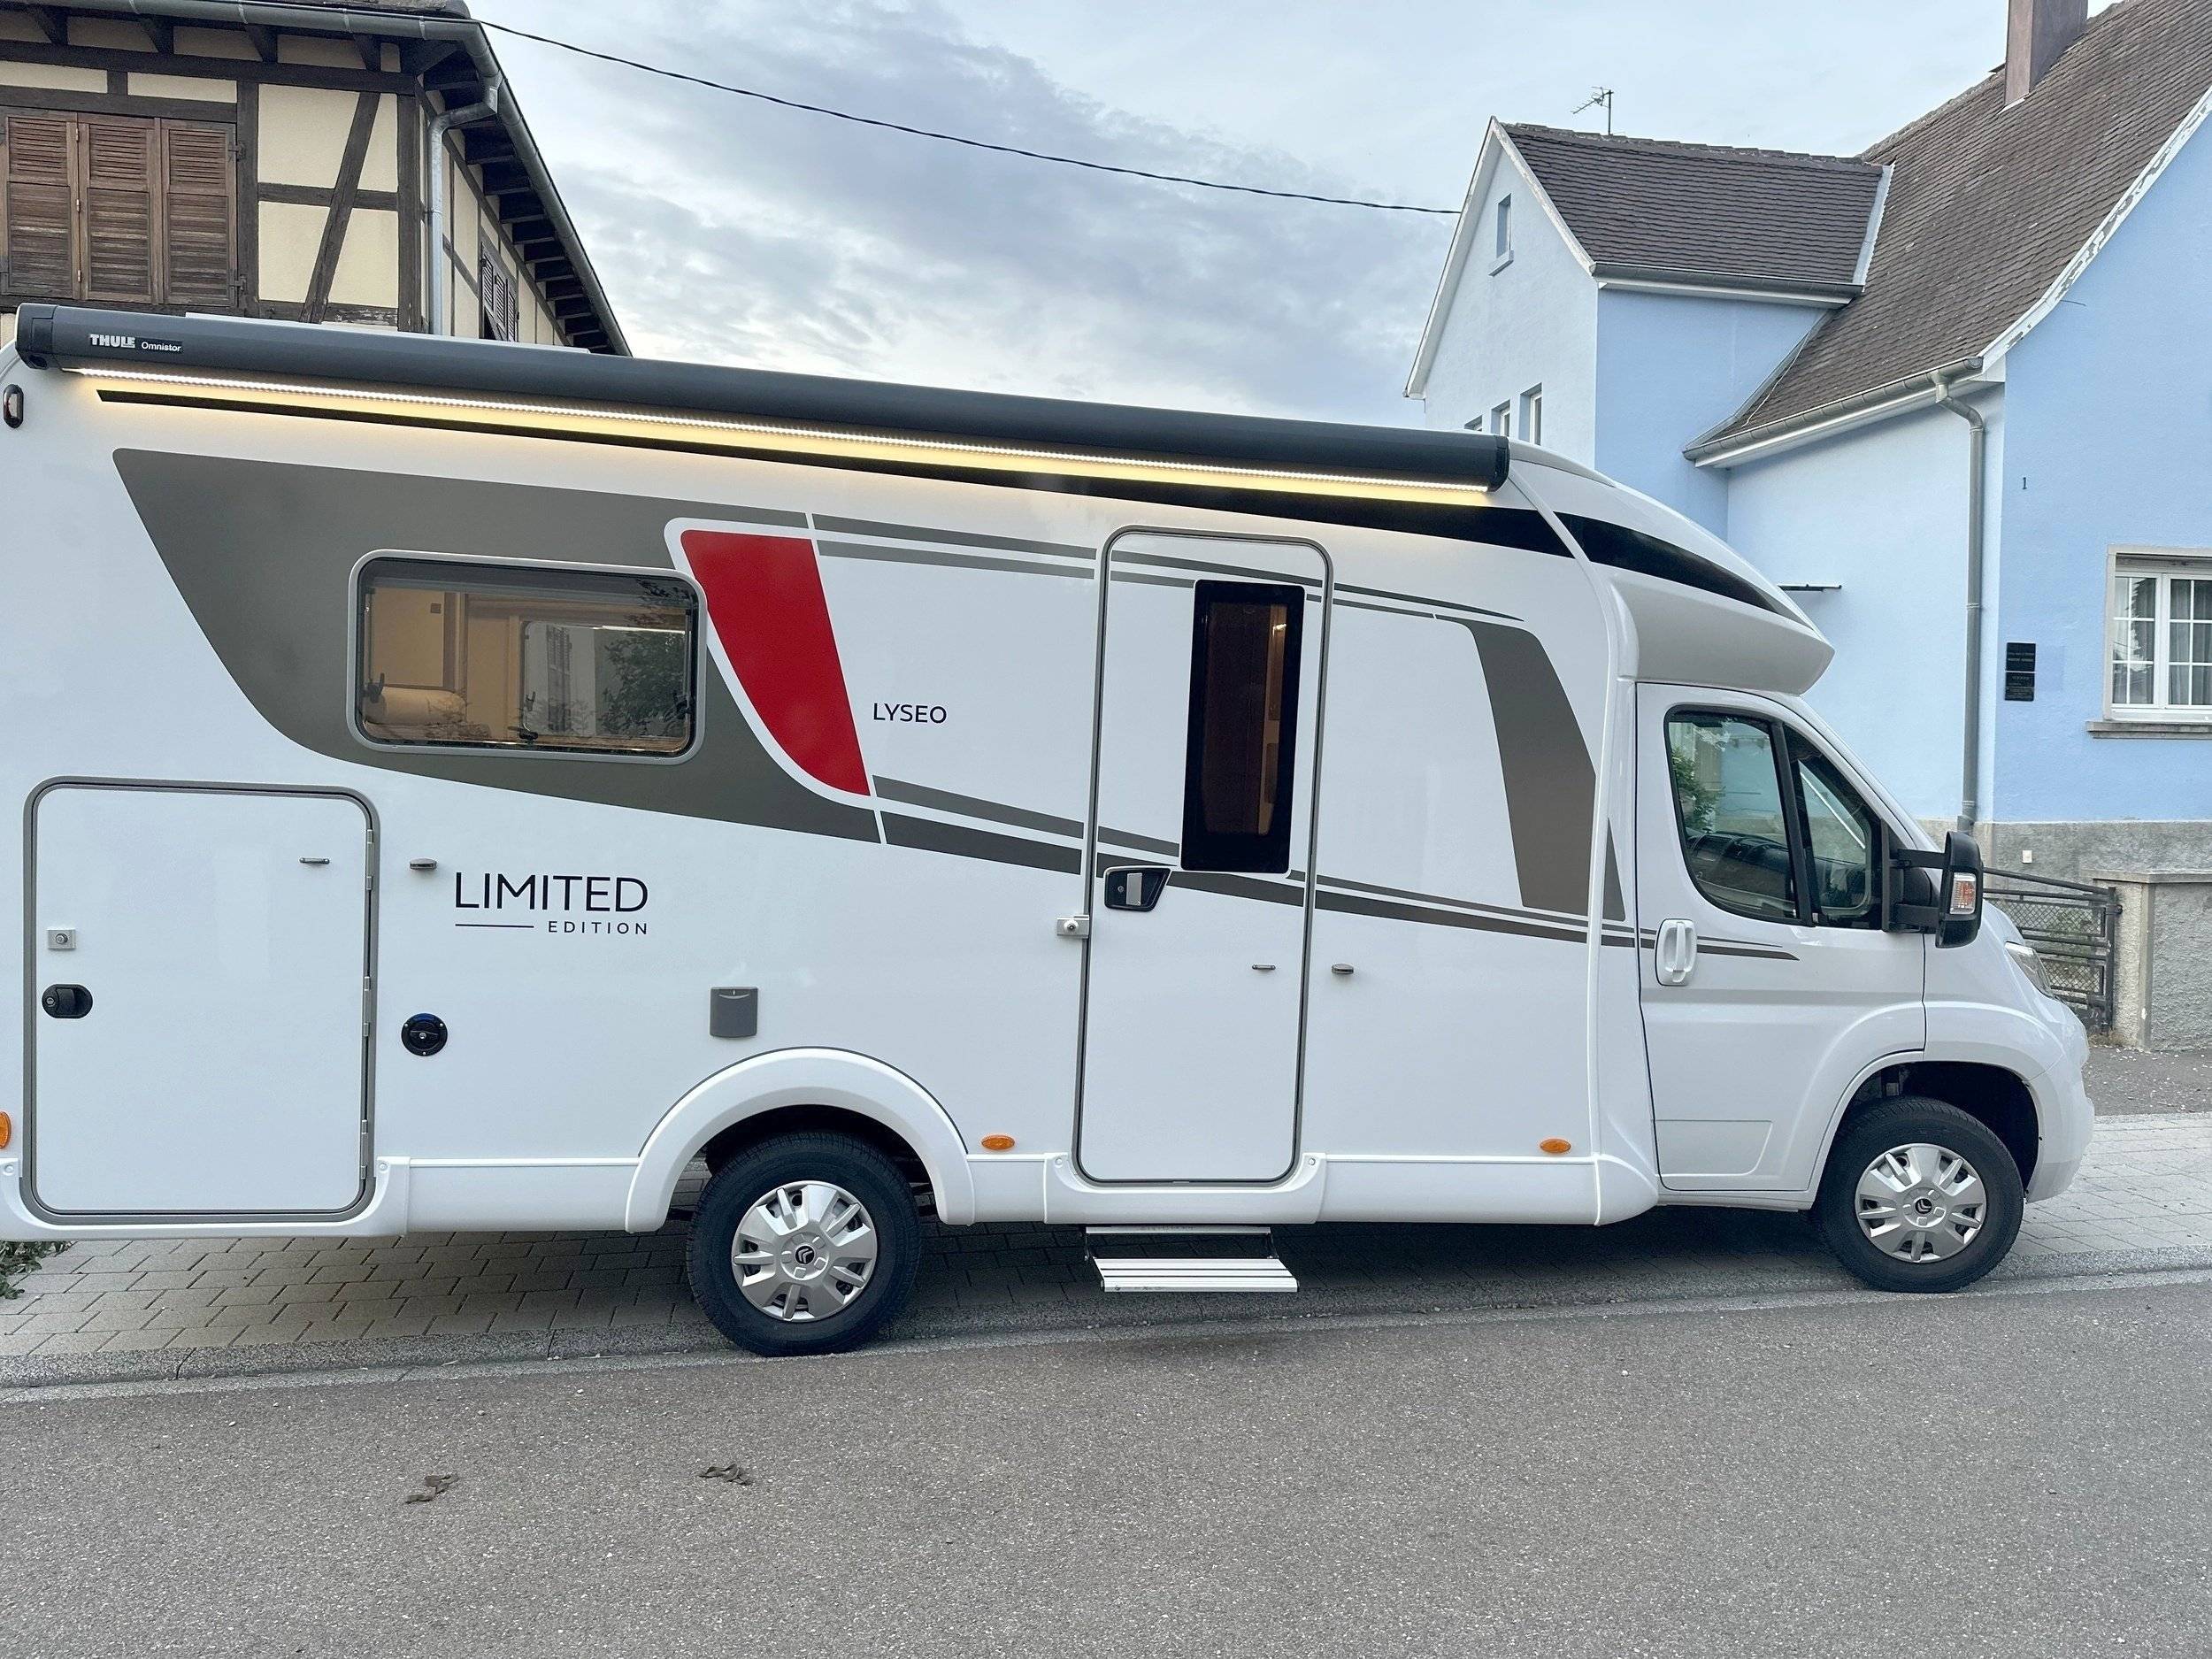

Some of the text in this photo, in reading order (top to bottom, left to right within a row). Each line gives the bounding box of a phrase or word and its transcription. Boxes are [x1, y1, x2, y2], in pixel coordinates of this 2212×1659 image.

[90, 334, 182, 352] THULE Omnistor
[873, 703, 947, 724] LYSEO
[455, 872, 649, 912] LIMITED
[548, 920, 648, 935] EDITION
